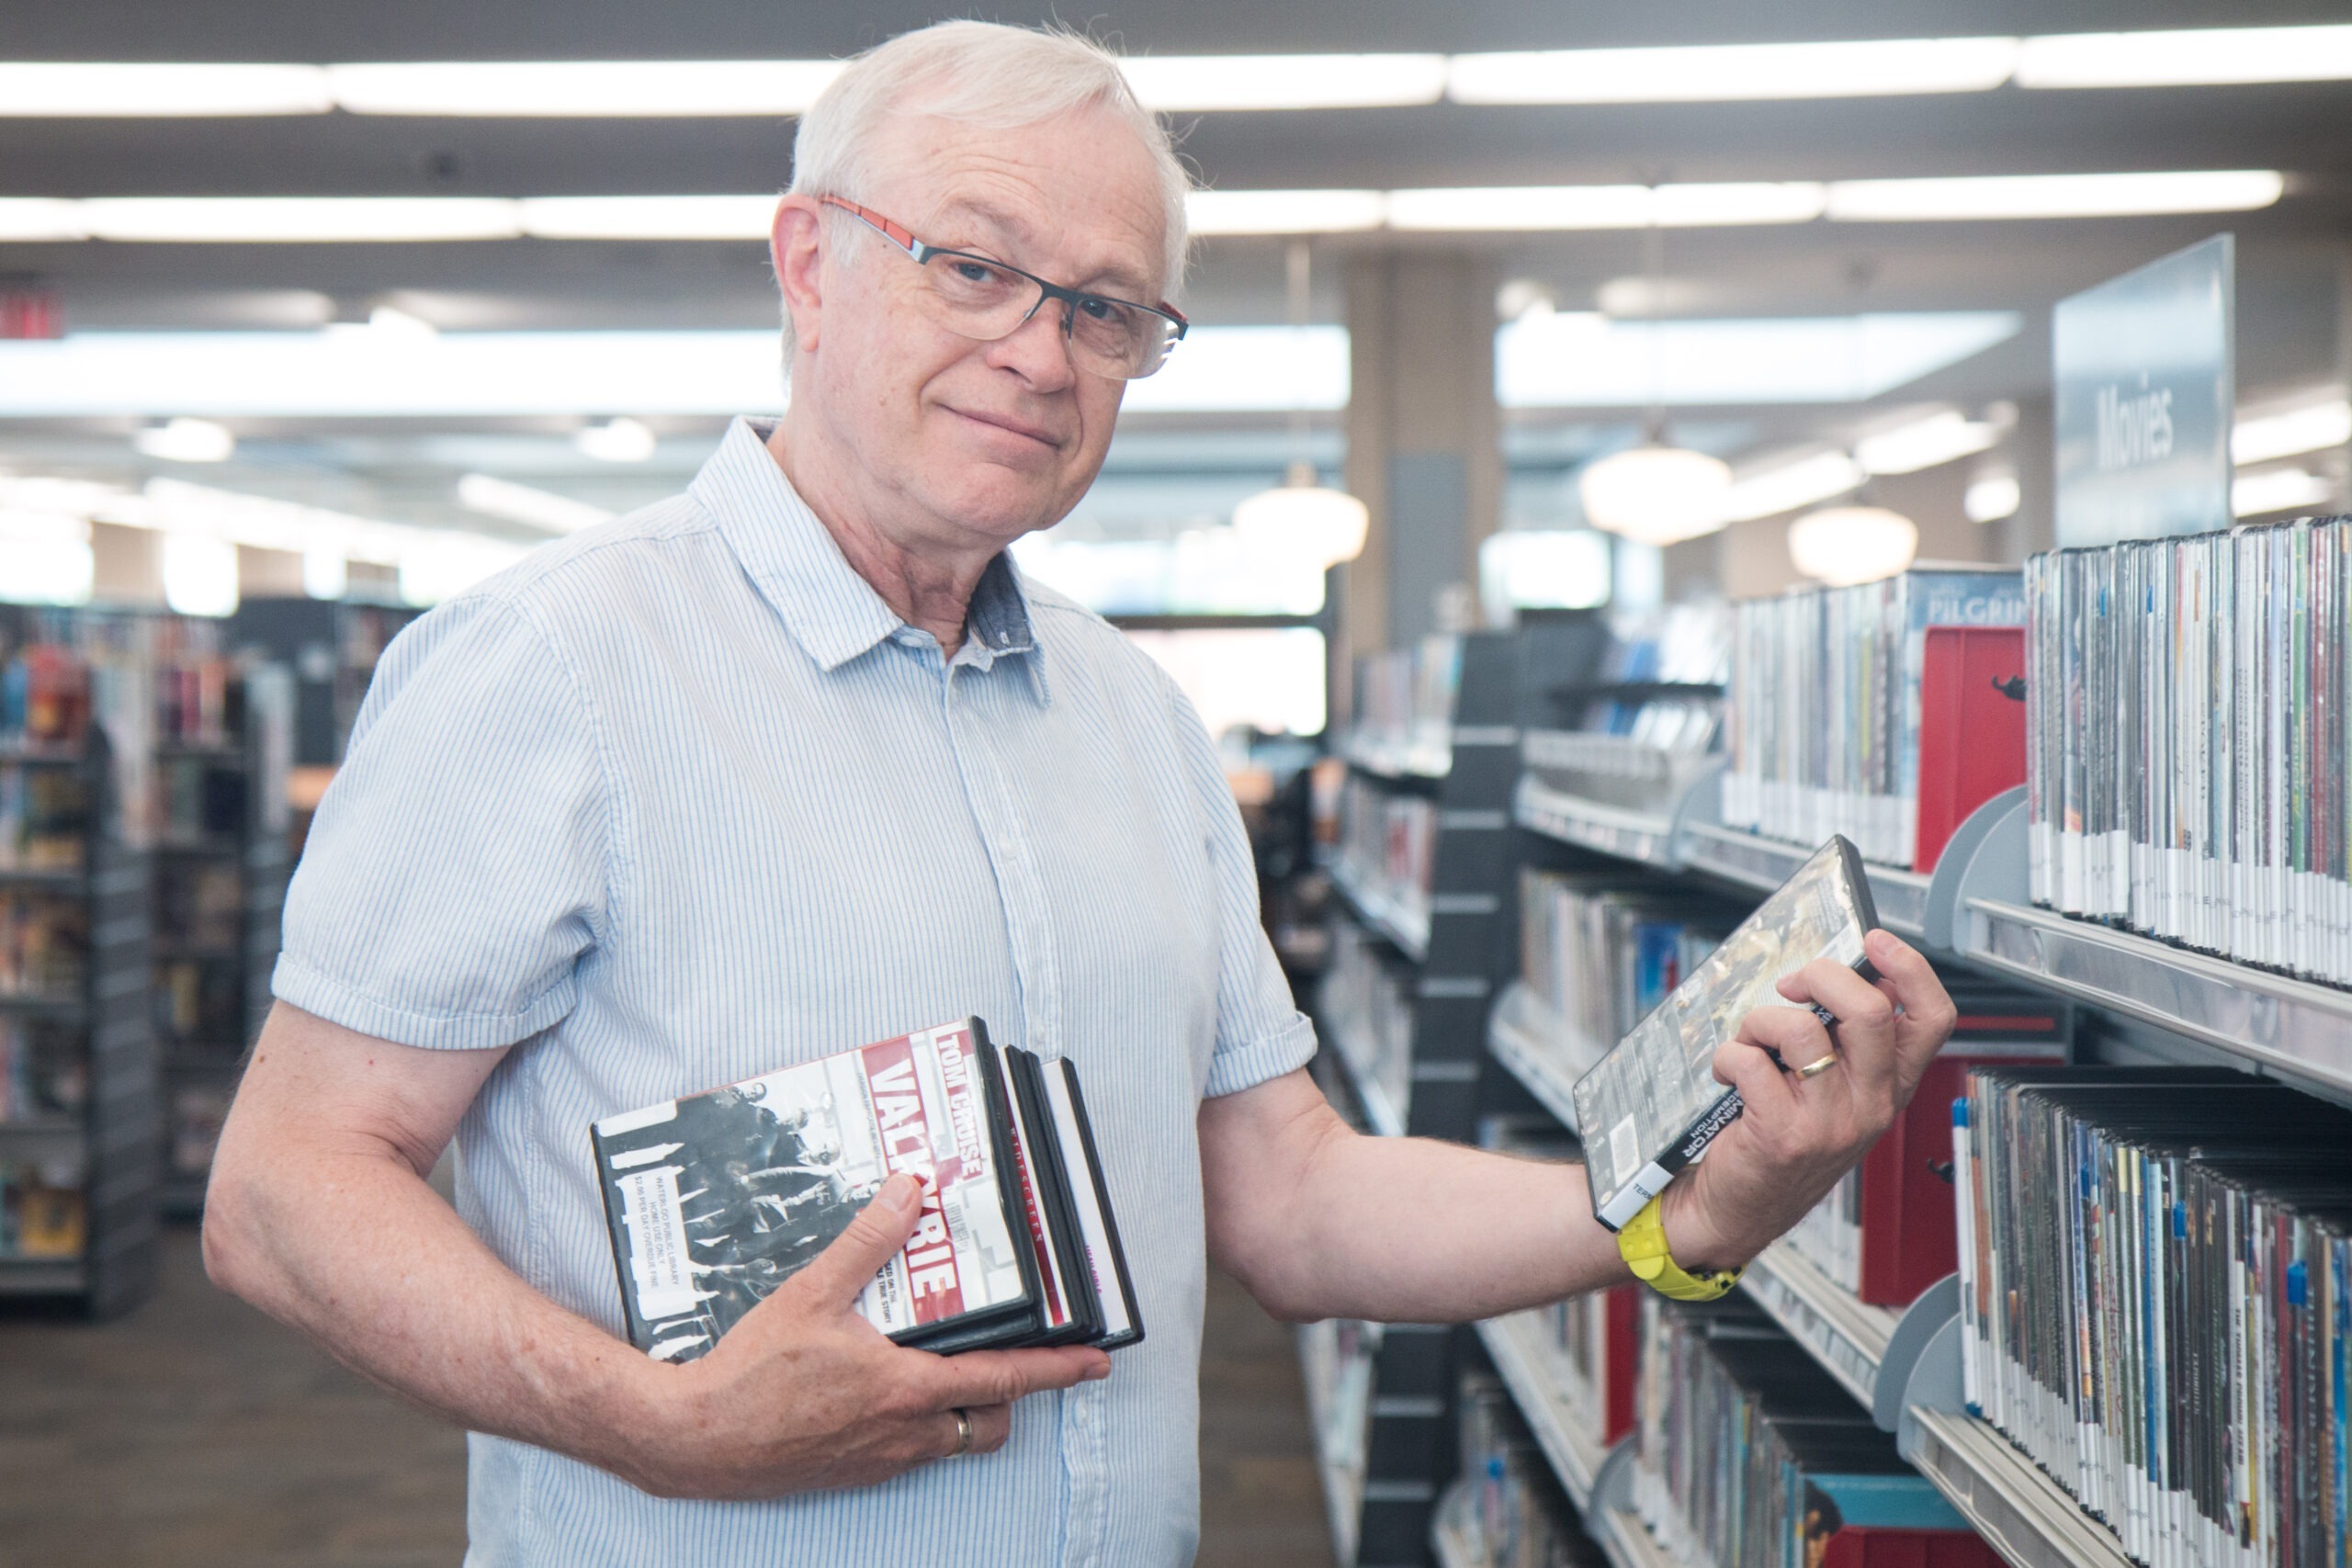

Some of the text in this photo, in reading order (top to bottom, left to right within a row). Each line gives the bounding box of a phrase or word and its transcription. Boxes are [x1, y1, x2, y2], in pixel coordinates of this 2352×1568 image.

[2098, 371, 2173, 470] Movies
[937, 1034, 982, 1178] TOM CRUISE
[1690, 1089, 1742, 1138] EDEMPTION
[1682, 1098, 1745, 1157] MINATOR
[1011, 1127, 1043, 1242] WIDESCREEN
[639, 1197, 648, 1213] PER
[641, 1214, 650, 1231] DAY
[650, 1201, 666, 1265] HOME USE ONLY
[656, 1177, 679, 1285] WATERLOO PUBLIC LIBRARY
[644, 1232, 656, 1269] OVERDUE
[650, 1270, 659, 1289] FINE
[885, 1262, 893, 1277] SED
[887, 1279, 895, 1289] ON
[878, 1281, 888, 1299] TRUE
[881, 1301, 891, 1324] STORY
